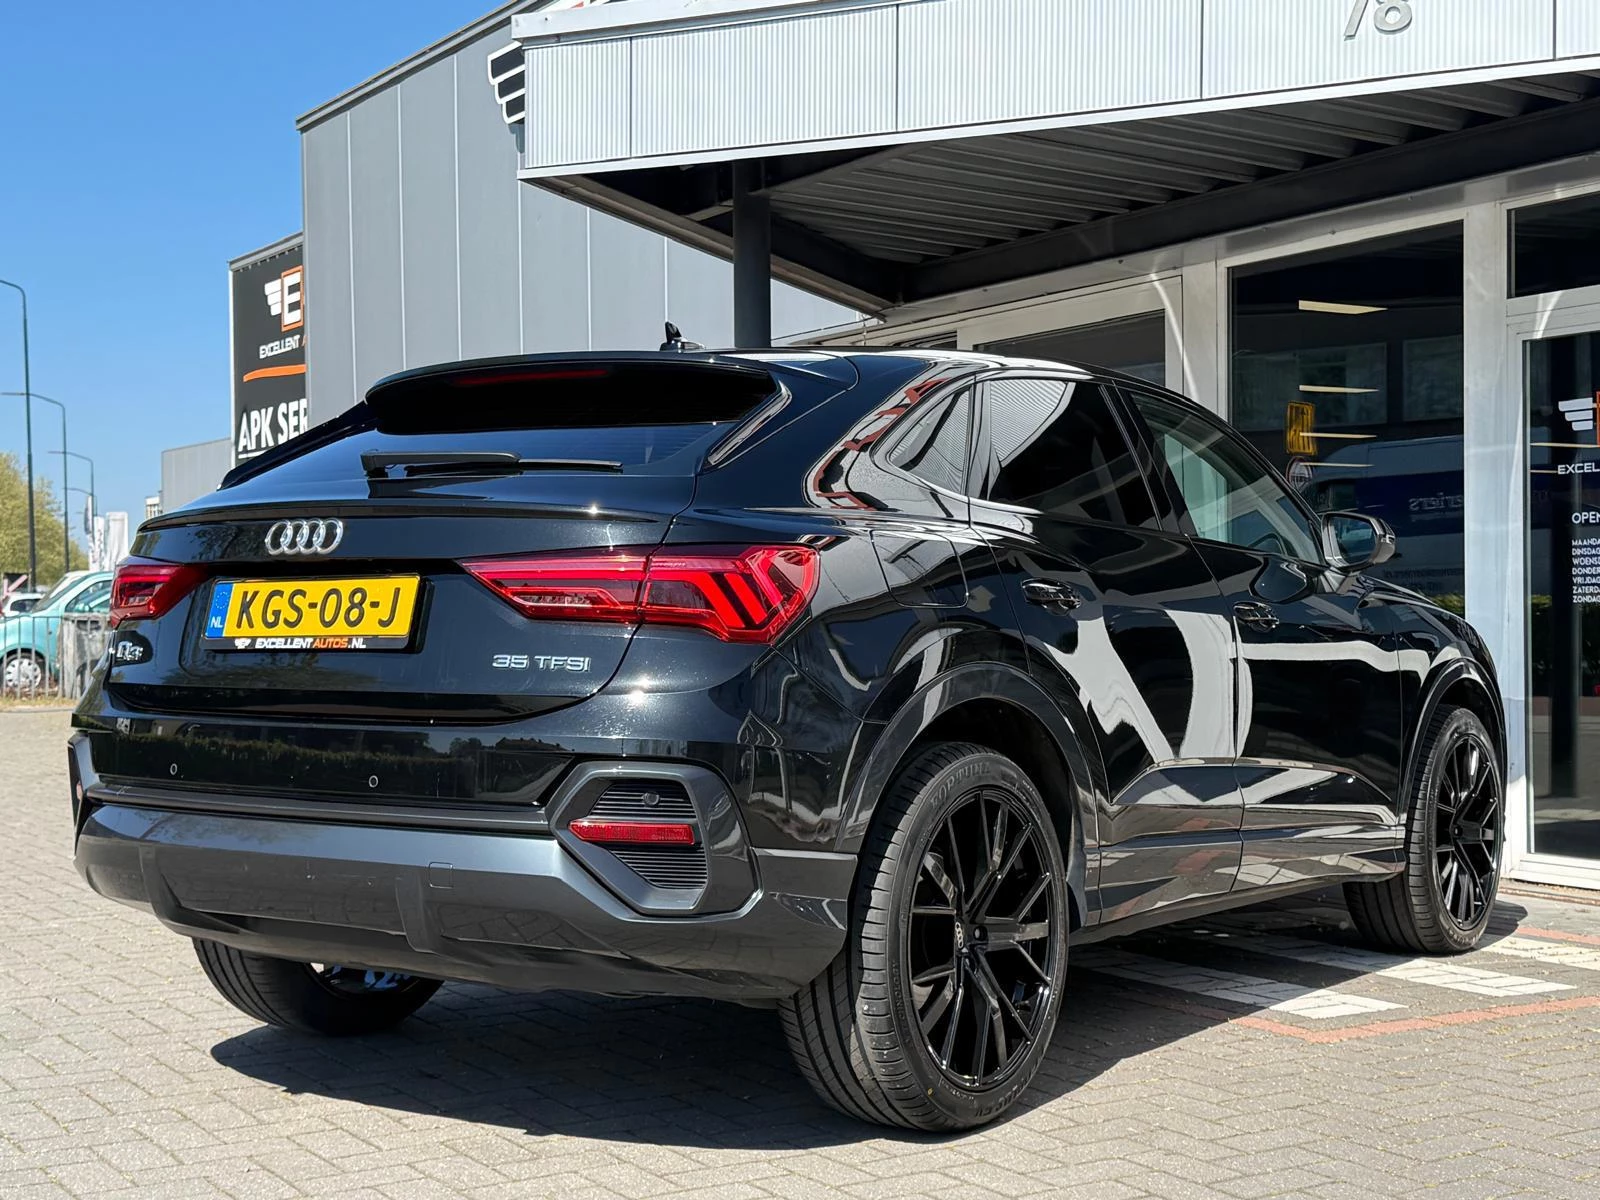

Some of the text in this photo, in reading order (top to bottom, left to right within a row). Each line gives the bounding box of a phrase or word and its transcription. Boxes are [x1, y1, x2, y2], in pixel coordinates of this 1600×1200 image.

[259, 335, 300, 359] EXCELLENT
[238, 407, 274, 452] APK
[236, 587, 401, 629] KGS-08-J
[210, 616, 223, 628] NL
[492, 654, 590, 672] 35 TFSI
